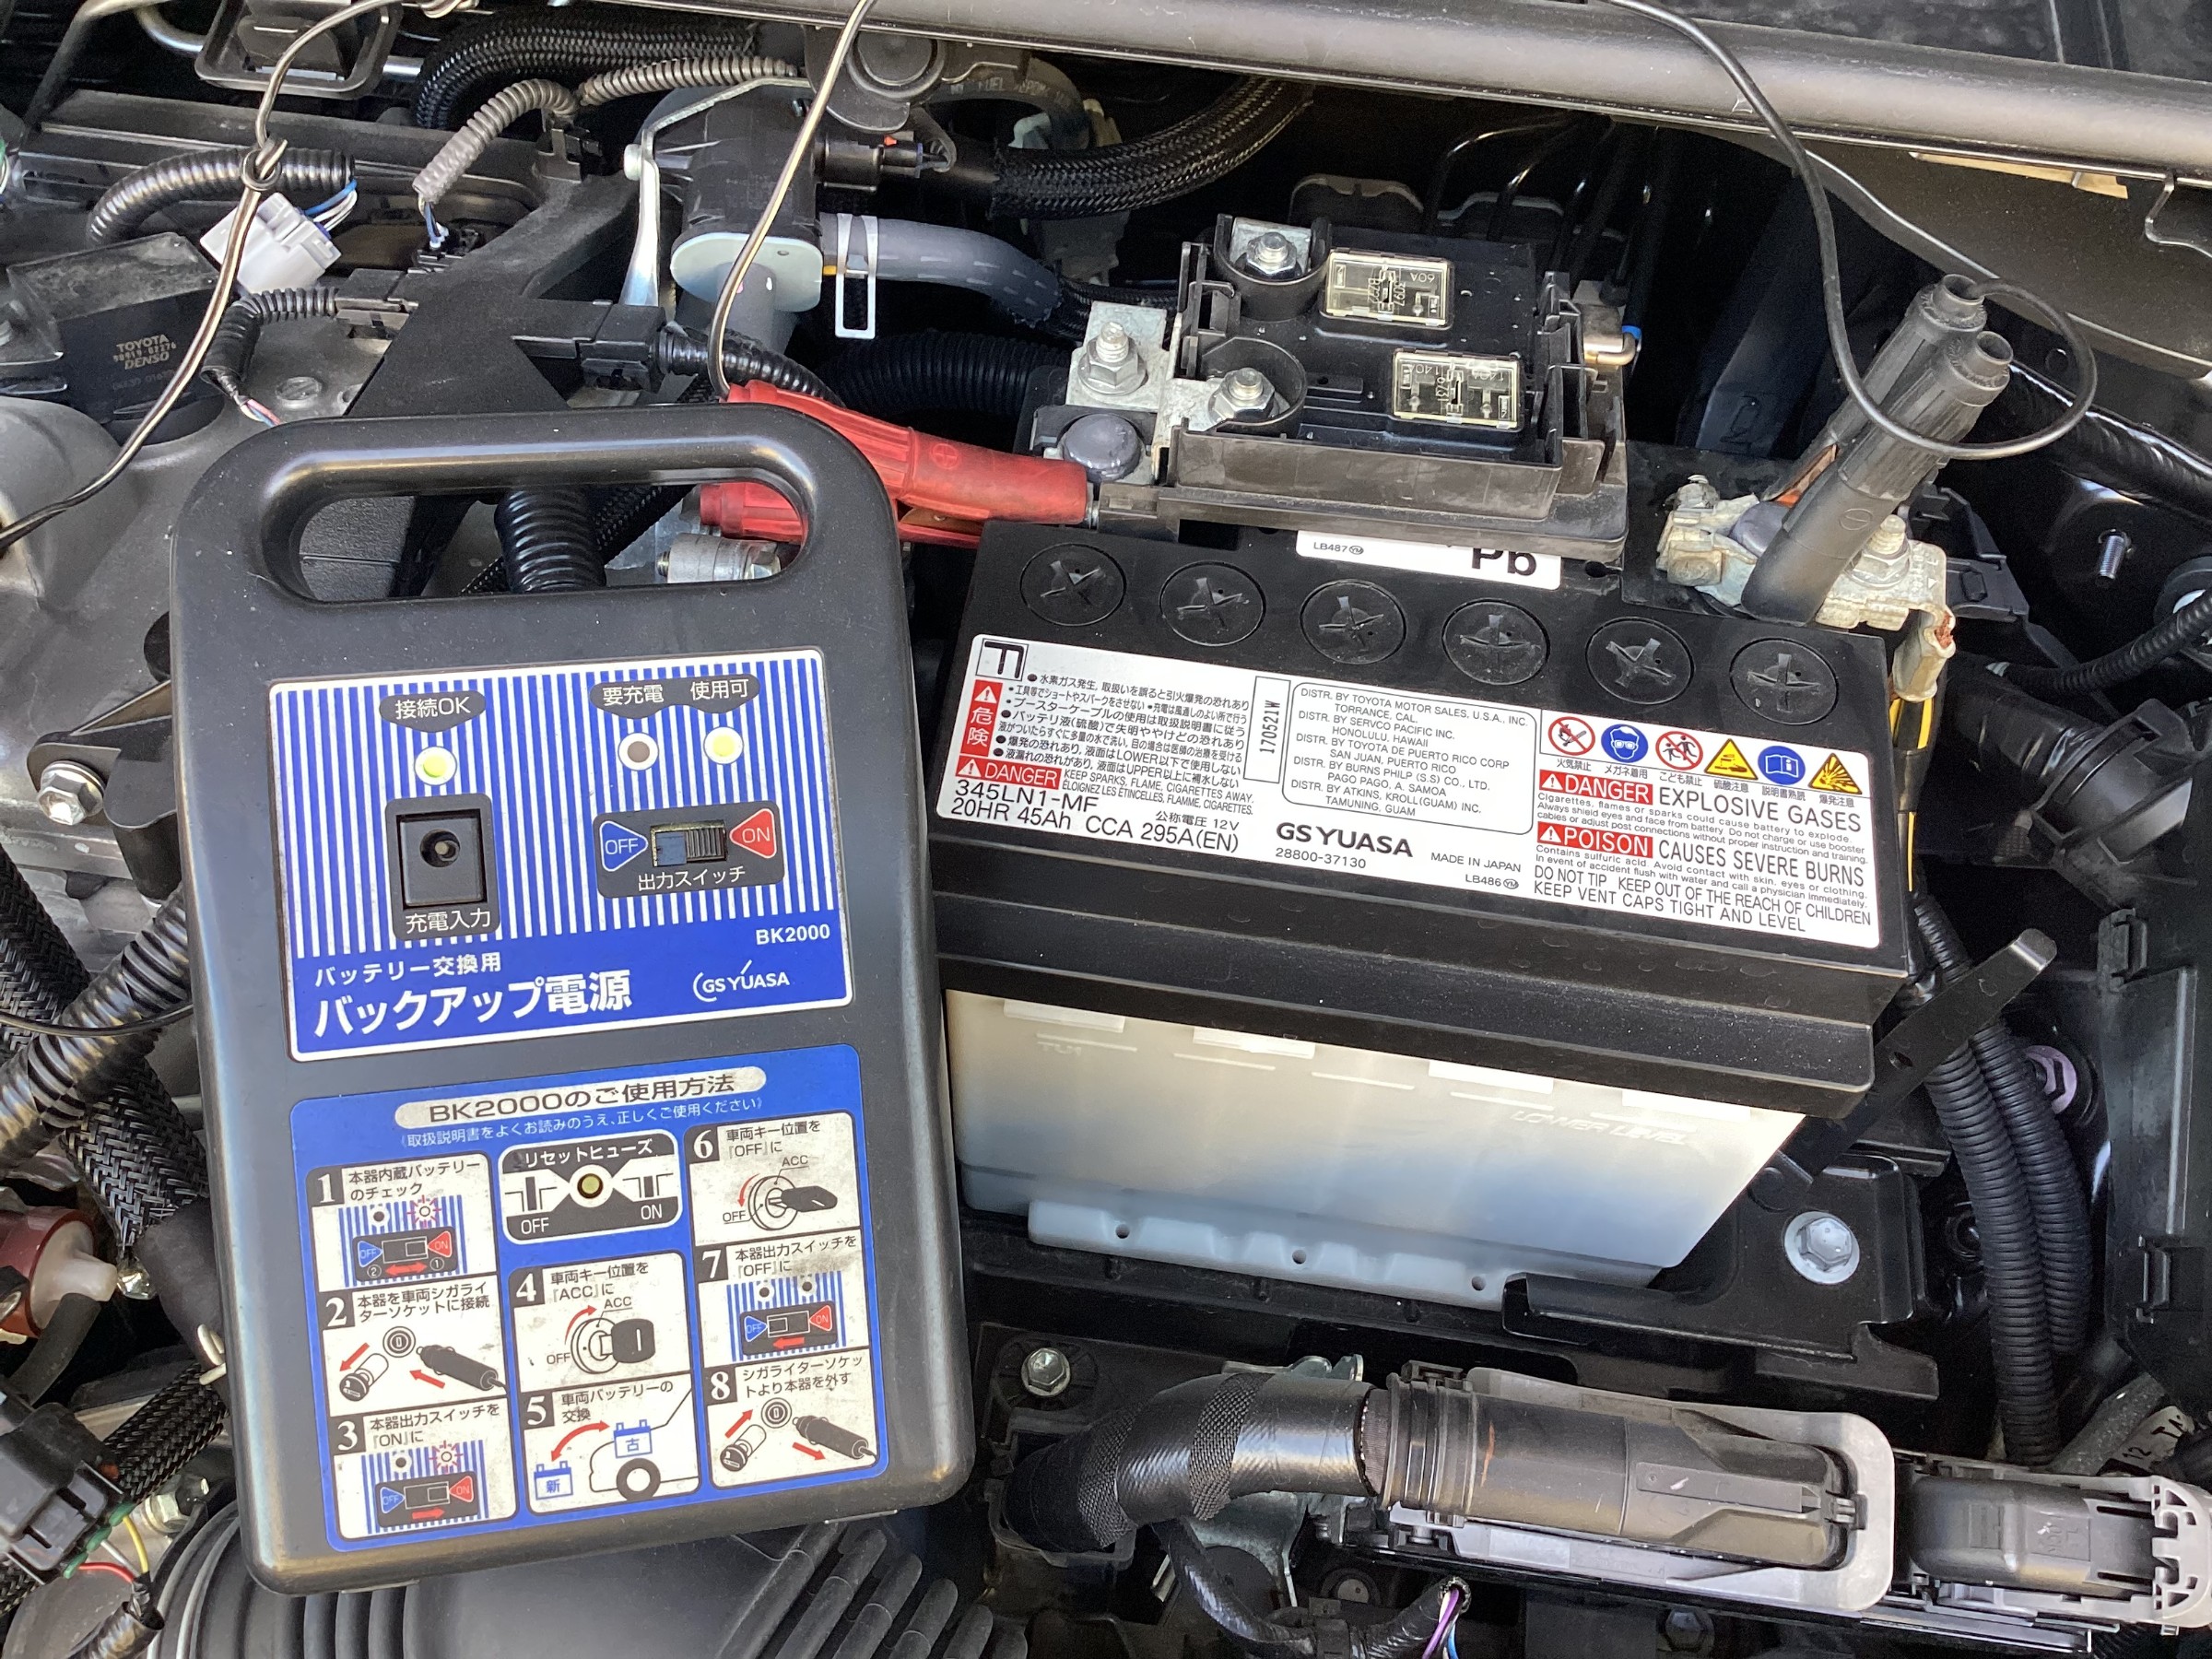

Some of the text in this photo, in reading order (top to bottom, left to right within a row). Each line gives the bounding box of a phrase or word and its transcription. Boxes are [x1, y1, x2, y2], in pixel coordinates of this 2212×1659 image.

[116, 334, 170, 353] TOYOTA
[124, 351, 171, 371] DENSO
[1313, 541, 1347, 553] LB487
[601, 683, 664, 707] 要充電
[689, 677, 749, 700] 使用可
[394, 694, 471, 720] 接続OK
[1335, 691, 1350, 701] BY
[1351, 694, 1393, 709] TOYOTA
[1394, 700, 1432, 714] MOTOR
[967, 706, 994, 747] 危険
[1258, 700, 1281, 755] 170521W
[1333, 714, 1347, 724] BY
[1349, 716, 1392, 731] SERVCO
[1394, 723, 1433, 737] PACIFIC
[1395, 712, 1418, 724] CAL.
[1393, 734, 1429, 747] HAWAII
[984, 762, 1057, 787] DANGER
[1063, 768, 1088, 781] KEEP
[1166, 782, 1223, 800] CIGARETTES
[1556, 758, 1592, 772] 火気禁止
[1604, 764, 1648, 780] メガネ着用
[1659, 771, 1703, 787] こども禁止
[954, 778, 1100, 813] 345LN1-MF
[1565, 773, 1650, 804] DANGER
[1155, 810, 1240, 831] 公称電圧 12V
[1659, 786, 1862, 833] EXPLOSIVE GASES
[741, 825, 771, 843] ON
[949, 796, 1239, 853] 20HR 45Ah CCA 295A(EN)
[604, 837, 639, 855] OFF
[1564, 826, 1648, 857] POISON
[1275, 847, 1367, 869] 28800-37130
[1430, 852, 1522, 873] MADE IN JAPAN
[1535, 843, 1581, 858] Contains
[1583, 853, 1621, 864] sulfuric
[1653, 860, 1683, 873] Avoid
[1686, 866, 1725, 878] contact
[1728, 872, 1750, 882] with
[1781, 880, 1806, 890] eyes
[1808, 884, 1819, 892] or
[1658, 839, 1865, 888] CAUSES SEVERE BURNS
[637, 864, 747, 891] 出力スイッチ
[1465, 873, 1502, 888] LB486
[1534, 864, 1871, 926] DO NOT TIP KEEP OUT OF THE REACH OF CHILDREN
[1534, 879, 1806, 933] KEEP VENT CAPS TIGHT AND LEVEL
[404, 906, 491, 934] 充電入力
[755, 923, 830, 945] BK2000
[313, 950, 501, 989] バッテリー交換用
[312, 967, 633, 1040] バックアップ電源
[429, 1073, 735, 1123] BK2000のご使用方法
[726, 1120, 820, 1142] 車両キー位置を
[1511, 1110, 1609, 1134] LOWER
[525, 1138, 653, 1167] リセットヒューズ
[692, 1129, 713, 1159] 6
[348, 1159, 480, 1185] 本器内蔵バッテリー
[782, 1155, 808, 1167] ACC
[317, 1173, 335, 1204] 1
[350, 1182, 423, 1201] のチェック
[641, 1204, 663, 1219] ON
[723, 1210, 746, 1222] OFF
[520, 1218, 549, 1234] OFF
[359, 1248, 377, 1258] OFF
[434, 1240, 448, 1250] ON
[735, 1234, 856, 1262] 本器出力スイッチを
[550, 1261, 648, 1285] 車両キー位置を
[701, 1250, 724, 1279] 7
[357, 1280, 488, 1309] 本器を車両シガライ
[514, 1273, 536, 1304] 4
[324, 1295, 348, 1326] 2
[358, 1295, 490, 1324] ターソケットに接続
[603, 1296, 631, 1309] ACC
[746, 1323, 761, 1334] OFF
[816, 1313, 829, 1324] ON
[546, 1352, 571, 1365] OFF
[742, 1354, 863, 1381] シガライターソケッ
[561, 1380, 673, 1406] 車両バッテリーの
[709, 1371, 730, 1401] 8
[746, 1372, 852, 1397] トより本器を外す
[370, 1403, 500, 1431] 本器出力スイッチを
[526, 1395, 547, 1425] 5
[561, 1408, 591, 1423] 交換
[335, 1419, 359, 1451] 3
[625, 1438, 640, 1452] 古
[455, 1485, 470, 1495] ON
[546, 1478, 560, 1493] 新
[382, 1494, 399, 1505] OFF
